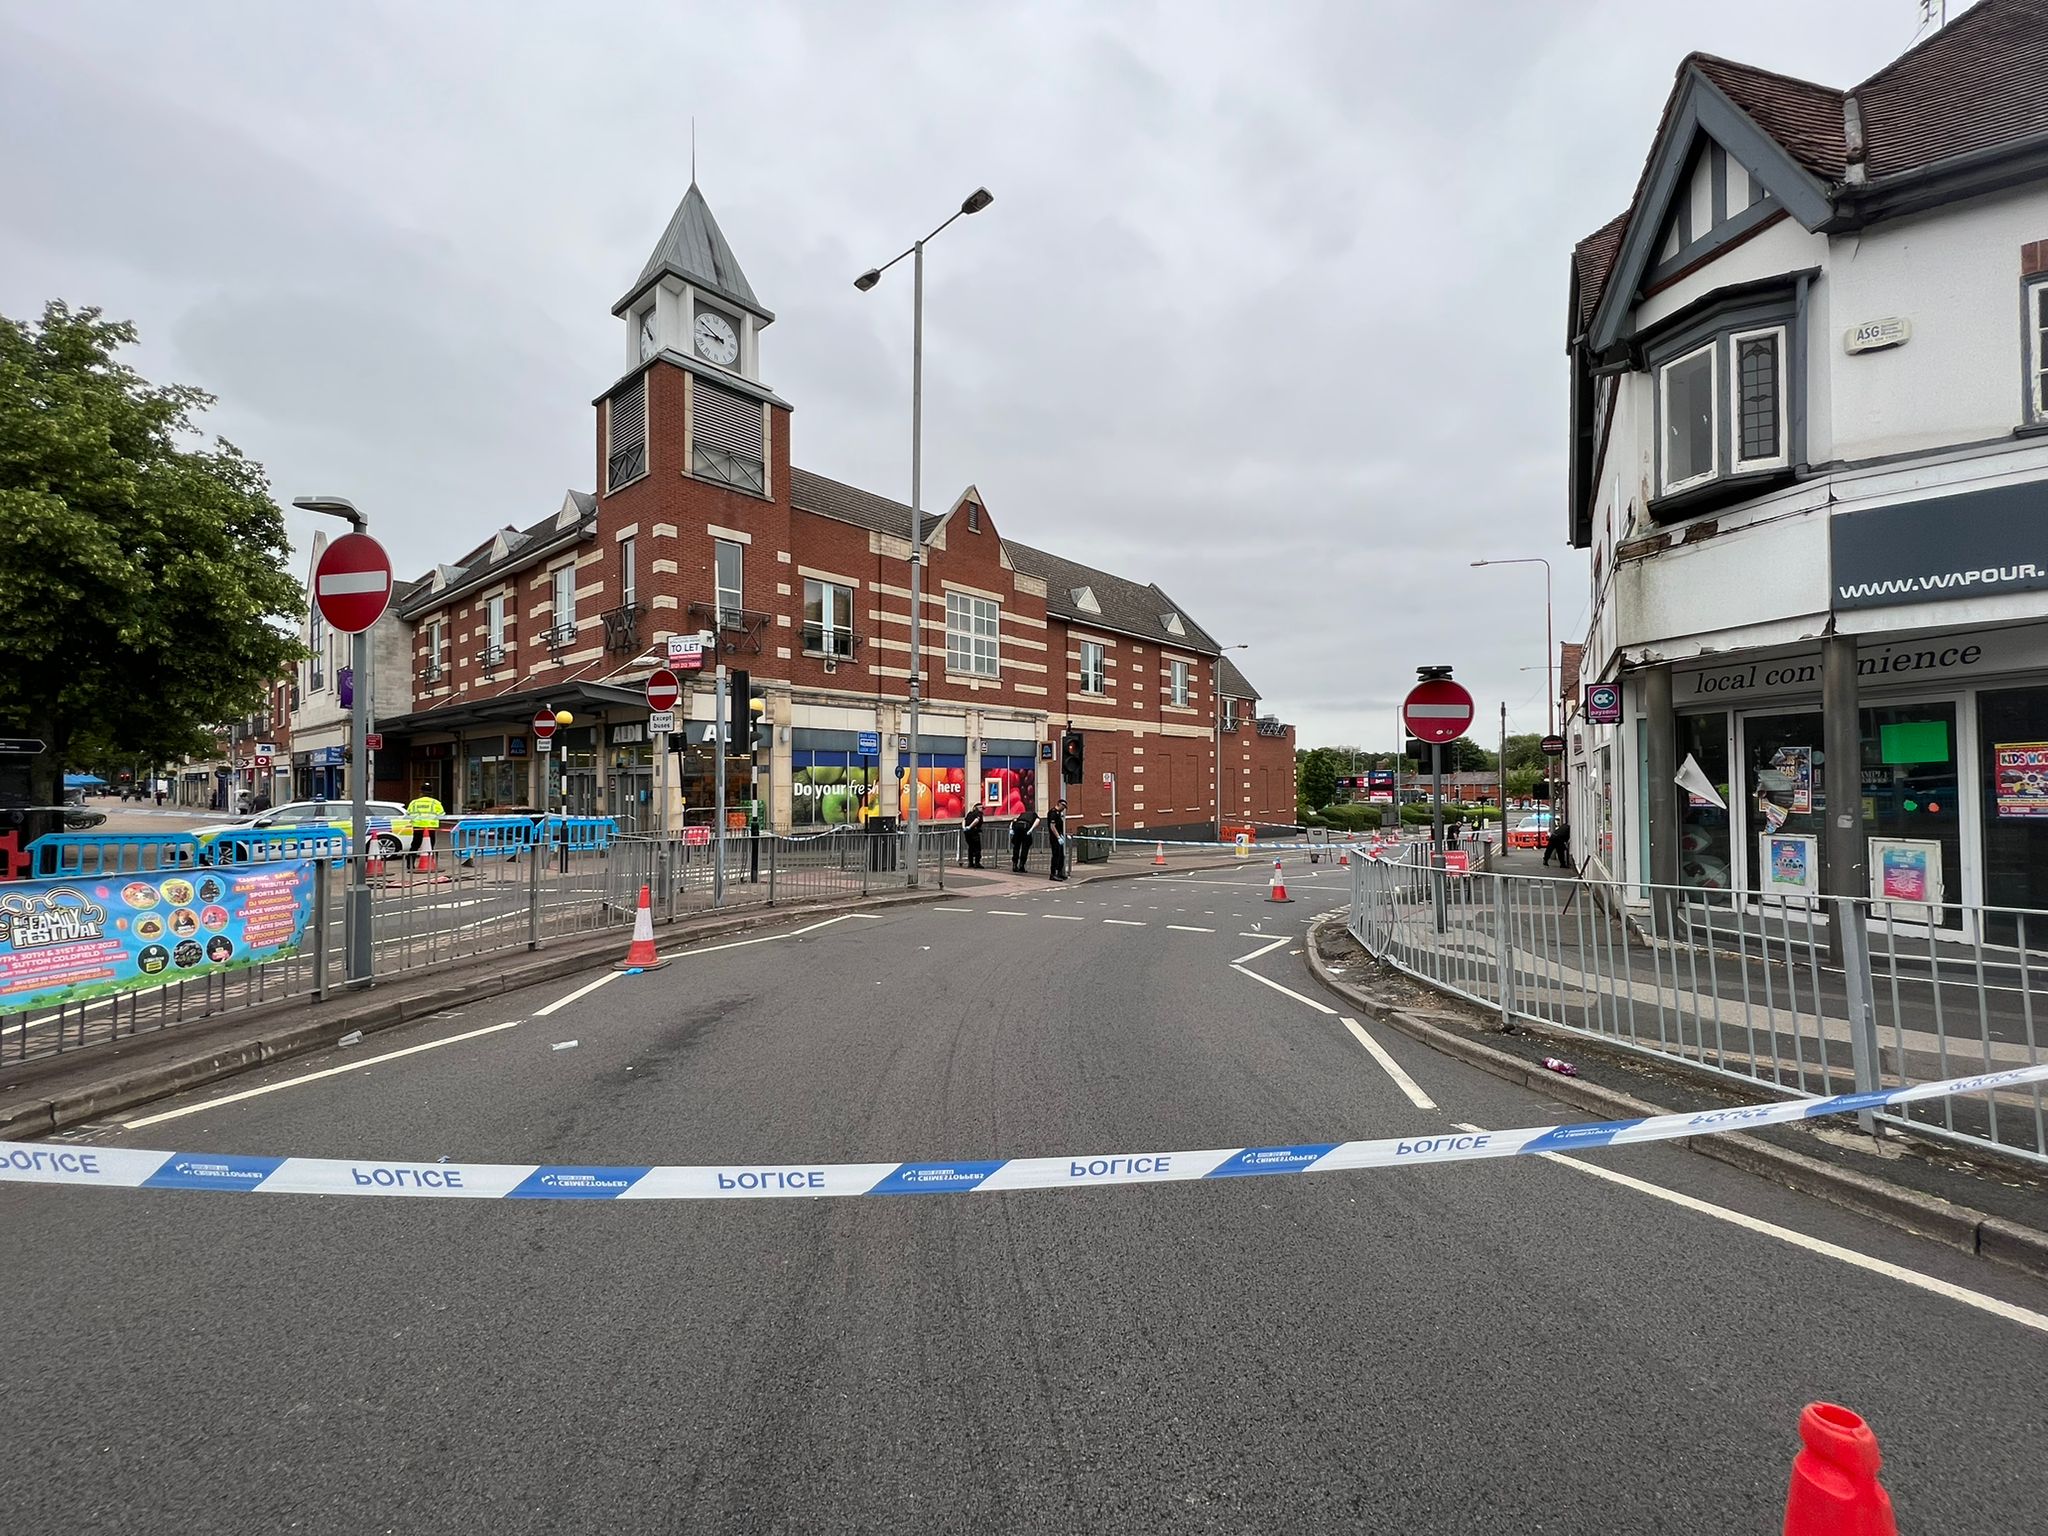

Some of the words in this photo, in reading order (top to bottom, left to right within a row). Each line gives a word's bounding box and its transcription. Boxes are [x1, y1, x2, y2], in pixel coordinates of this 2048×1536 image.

[1857, 326, 1880, 341] ASG
[671, 644, 682, 653] TO
[684, 643, 699, 652] LET
[1694, 665, 1757, 694] local
[1765, 645, 1982, 686] connience
[652, 714, 672, 722] Except
[613, 724, 642, 743] ALDI
[702, 724, 732, 742] AL
[2001, 753, 2026, 765] KIDS
[2027, 751, 2048, 764] WO
[794, 782, 812, 796] Do
[814, 783, 846, 799] your
[937, 781, 961, 793] here
[257, 837, 342, 853] POLIC
[249, 890, 274, 898] SPORTS
[238, 907, 263, 917] DANCE
[13, 922, 101, 946] FESTIVAL
[0, 955, 18, 963] TH,
[21, 951, 45, 960] 30TH
[76, 944, 97, 953] JULY
[98, 940, 118, 949] 2022
[12, 957, 51, 969] SUTTON
[53, 950, 101, 963] COLDFIELD
